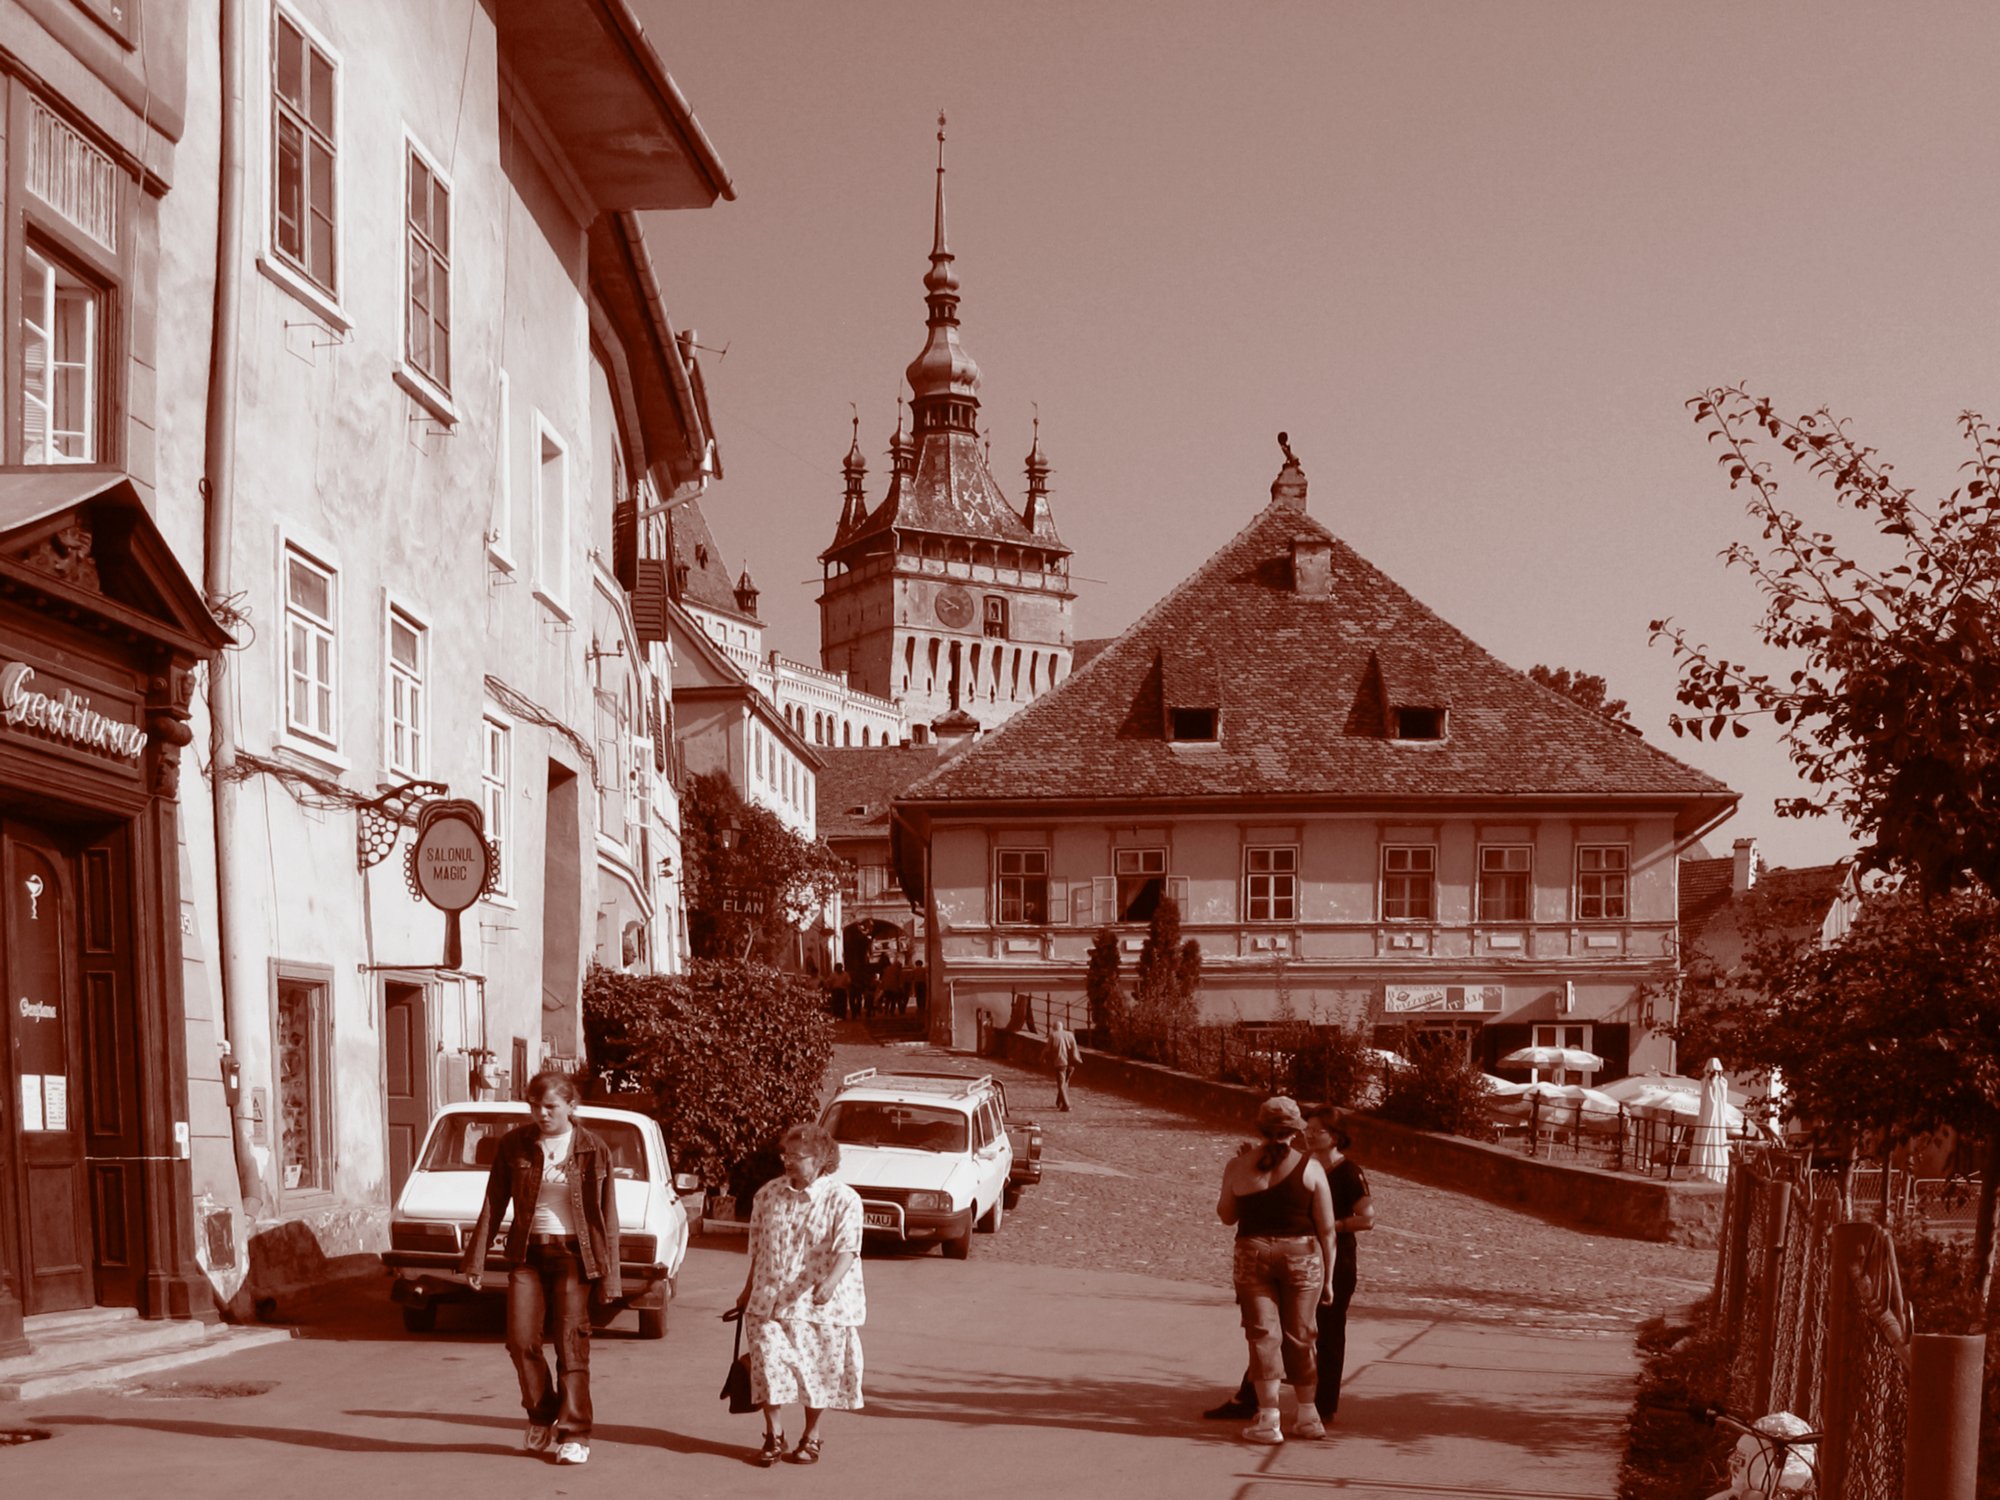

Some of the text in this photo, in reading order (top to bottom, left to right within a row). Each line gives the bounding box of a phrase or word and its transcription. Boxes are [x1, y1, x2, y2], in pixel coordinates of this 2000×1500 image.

[3, 663, 149, 757] Gentiana
[426, 847, 475, 862] SALONUL
[433, 866, 468, 881] MAGIC
[723, 899, 764, 915] ELAN
[1395, 991, 1442, 1011] PIZZERIA
[1447, 987, 1502, 1011] ITALIANA
[867, 1214, 890, 1225] NAU
